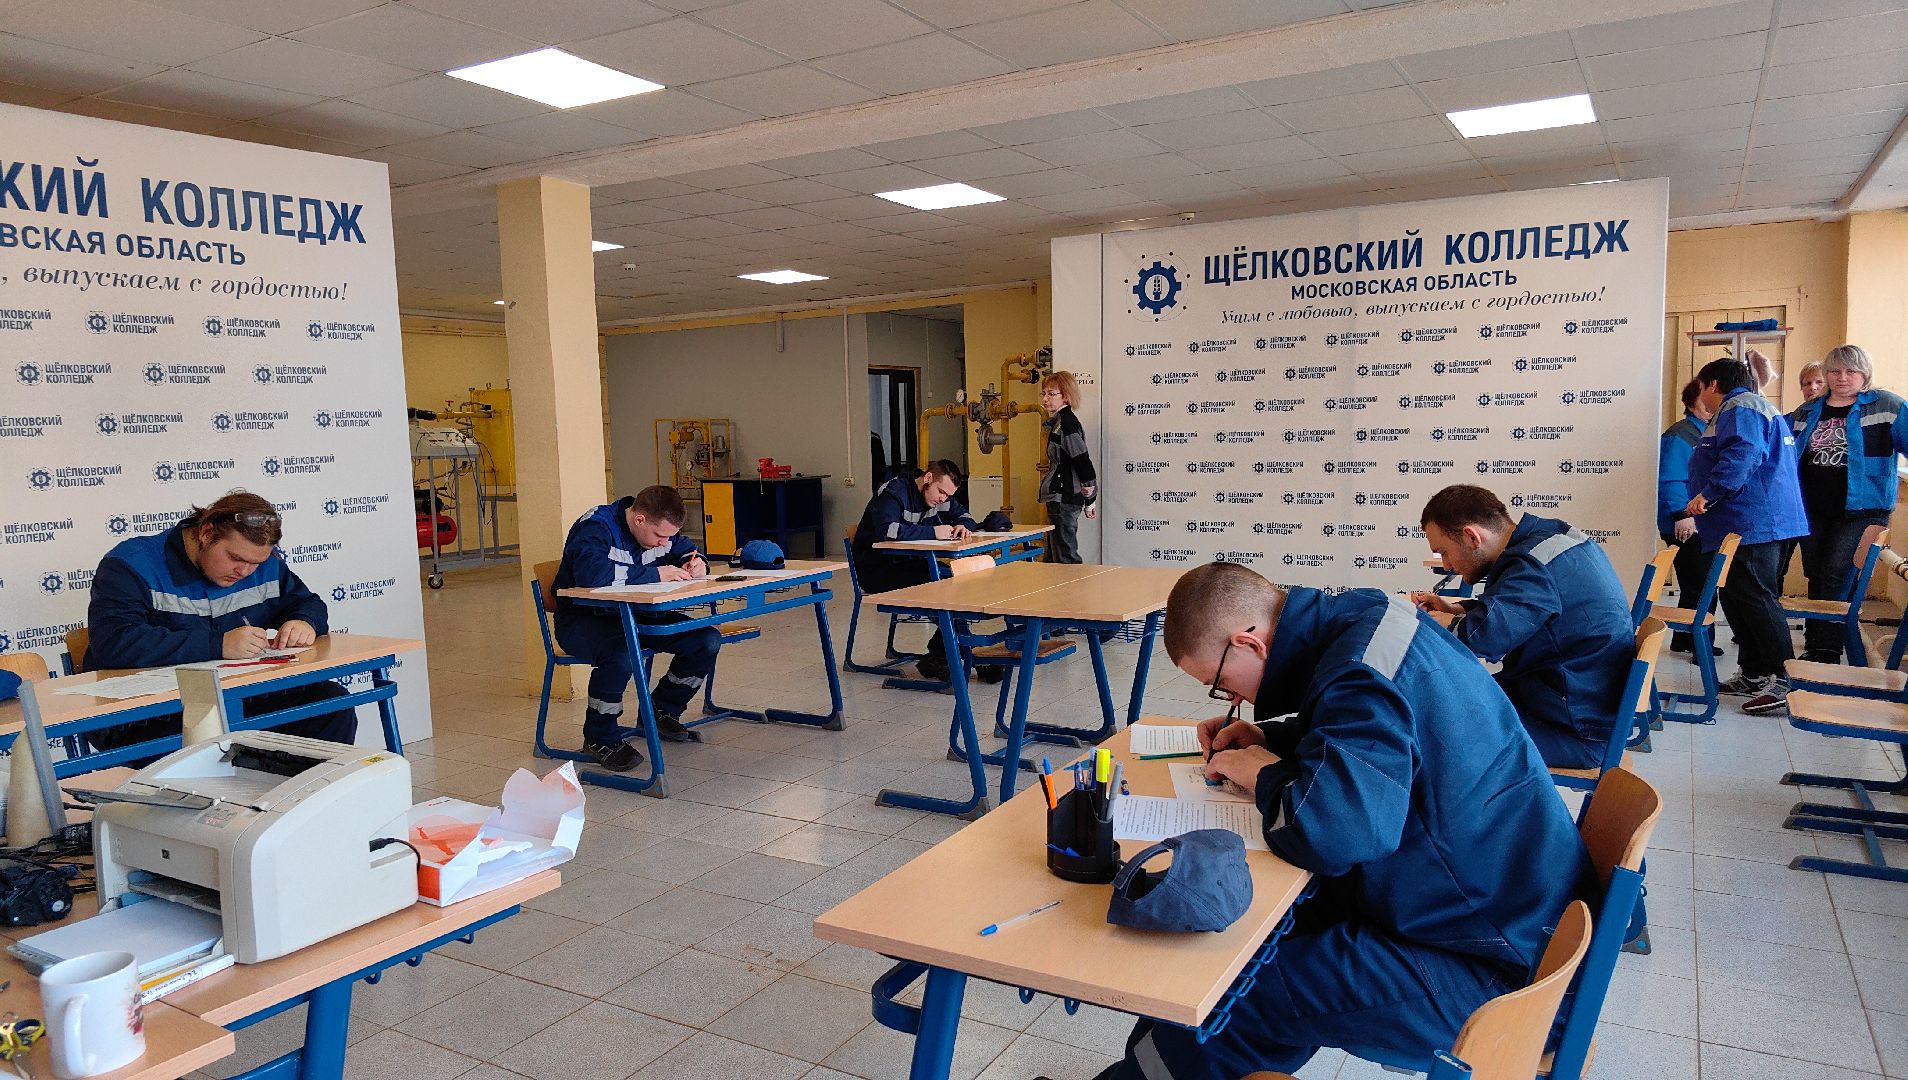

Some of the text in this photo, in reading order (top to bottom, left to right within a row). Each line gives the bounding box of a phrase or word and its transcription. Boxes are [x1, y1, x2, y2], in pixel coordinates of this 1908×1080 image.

[140, 178, 366, 246] КОЛЛЕДЖ
[116, 234, 246, 265] ОБЛАСТЬ
[1204, 219, 1630, 286] ЩЁЛКОВСКИЙ КОЛЛЕДЖ
[24, 267, 348, 300] выпускаем с гордостью!
[1291, 270, 1518, 300] МОСКОВСКАЯ ОБЛАСТЬ
[1221, 286, 1606, 324] Учим с любовью, выпускаем с гордостью!
[113, 313, 174, 324] ЩЁЛКОВСКИЙ
[227, 318, 280, 328] ЩЁЛКОВСКИЙ
[113, 324, 158, 334] КОЛЛЕДЖ
[327, 322, 375, 332] ЩЁЛКОВСКИЙ
[227, 328, 266, 337] КОЛЛЕДЖ
[328, 332, 362, 341] КОЛЛЕДЖ
[45, 362, 111, 373] ЩЁЛКОВСКИЙ
[168, 364, 225, 374] ЩЁЛКОВСКИЙ
[275, 365, 326, 375] ЩЁЛКОВСКИЙ
[46, 375, 94, 384] КОЛЛЕДЖ
[169, 376, 210, 384] КОЛЛЕДЖ
[276, 376, 313, 384] КОЛЛЕДЖ
[122, 412, 183, 424] ЩЁЛКОВСКИЙ
[235, 411, 288, 421] ЩЁЛКОВСКИЙ
[335, 409, 382, 419] ЩЁЛКОВСКИЙ
[0, 415, 62, 427] ЁЛКОВСКИЙ
[236, 422, 274, 430] КОЛЛЕДЖ
[0, 428, 44, 437] ОЛЛЕДЖ
[124, 425, 167, 433] КОЛЛЕДЖ
[178, 458, 234, 471] ЩЁЛКОВСКИЙ
[284, 454, 334, 465] ЩЁЛКОВСКИЙ
[56, 464, 122, 478] ЩЁЛКОВСКИЙ
[284, 465, 321, 474] КОЛЛЕДЖ
[179, 471, 220, 480] КОЛЛЕДЖ
[57, 477, 104, 487] КОЛЛЕДЖ
[343, 494, 389, 506] ЩЁЛКОВСКИЙ
[272, 501, 296, 511] ВСКИЙ
[344, 505, 377, 514] КОЛЛЕДЖ
[4, 518, 73, 534] ЩЁЛКОВСКИЙ
[6, 532, 55, 544] КОЛЛЕДЖ
[292, 541, 341, 555] ЩЁЛКОВСКИЙ
[293, 553, 328, 563] КОЛЛЕДЖ
[350, 578, 395, 591] ЩЁЛКОВСКИЙ
[351, 589, 384, 600] КОЛЛЕДЖ
[17, 620, 84, 640] ЩЁЛКОВСКИЙ
[17, 635, 66, 650] КОЛЛЕДЖ
